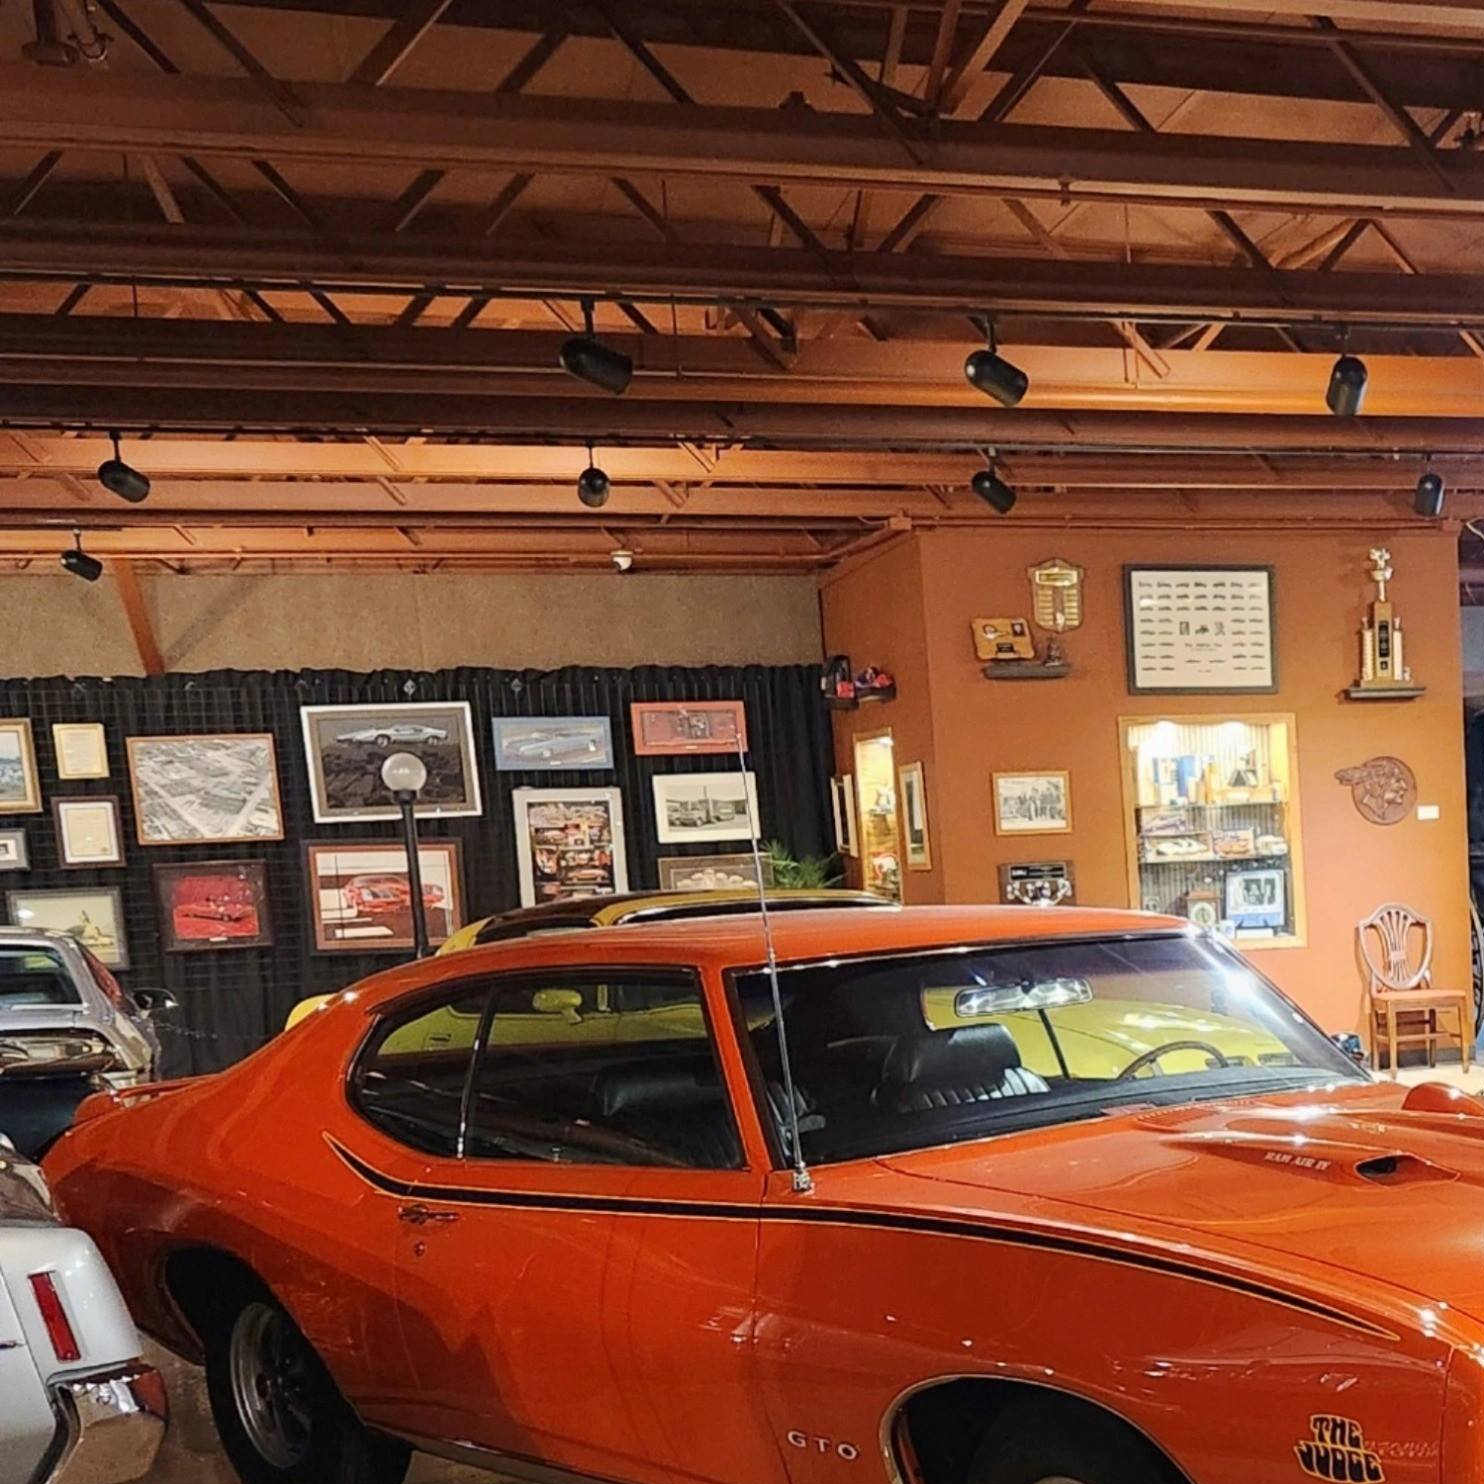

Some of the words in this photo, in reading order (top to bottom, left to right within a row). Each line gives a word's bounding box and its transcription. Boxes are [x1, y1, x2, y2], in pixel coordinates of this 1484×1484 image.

[1264, 1151, 1292, 1163] RAM
[1292, 1156, 1316, 1168] AIR
[787, 1430, 858, 1460] GTO
[1310, 1414, 1363, 1450] THE
